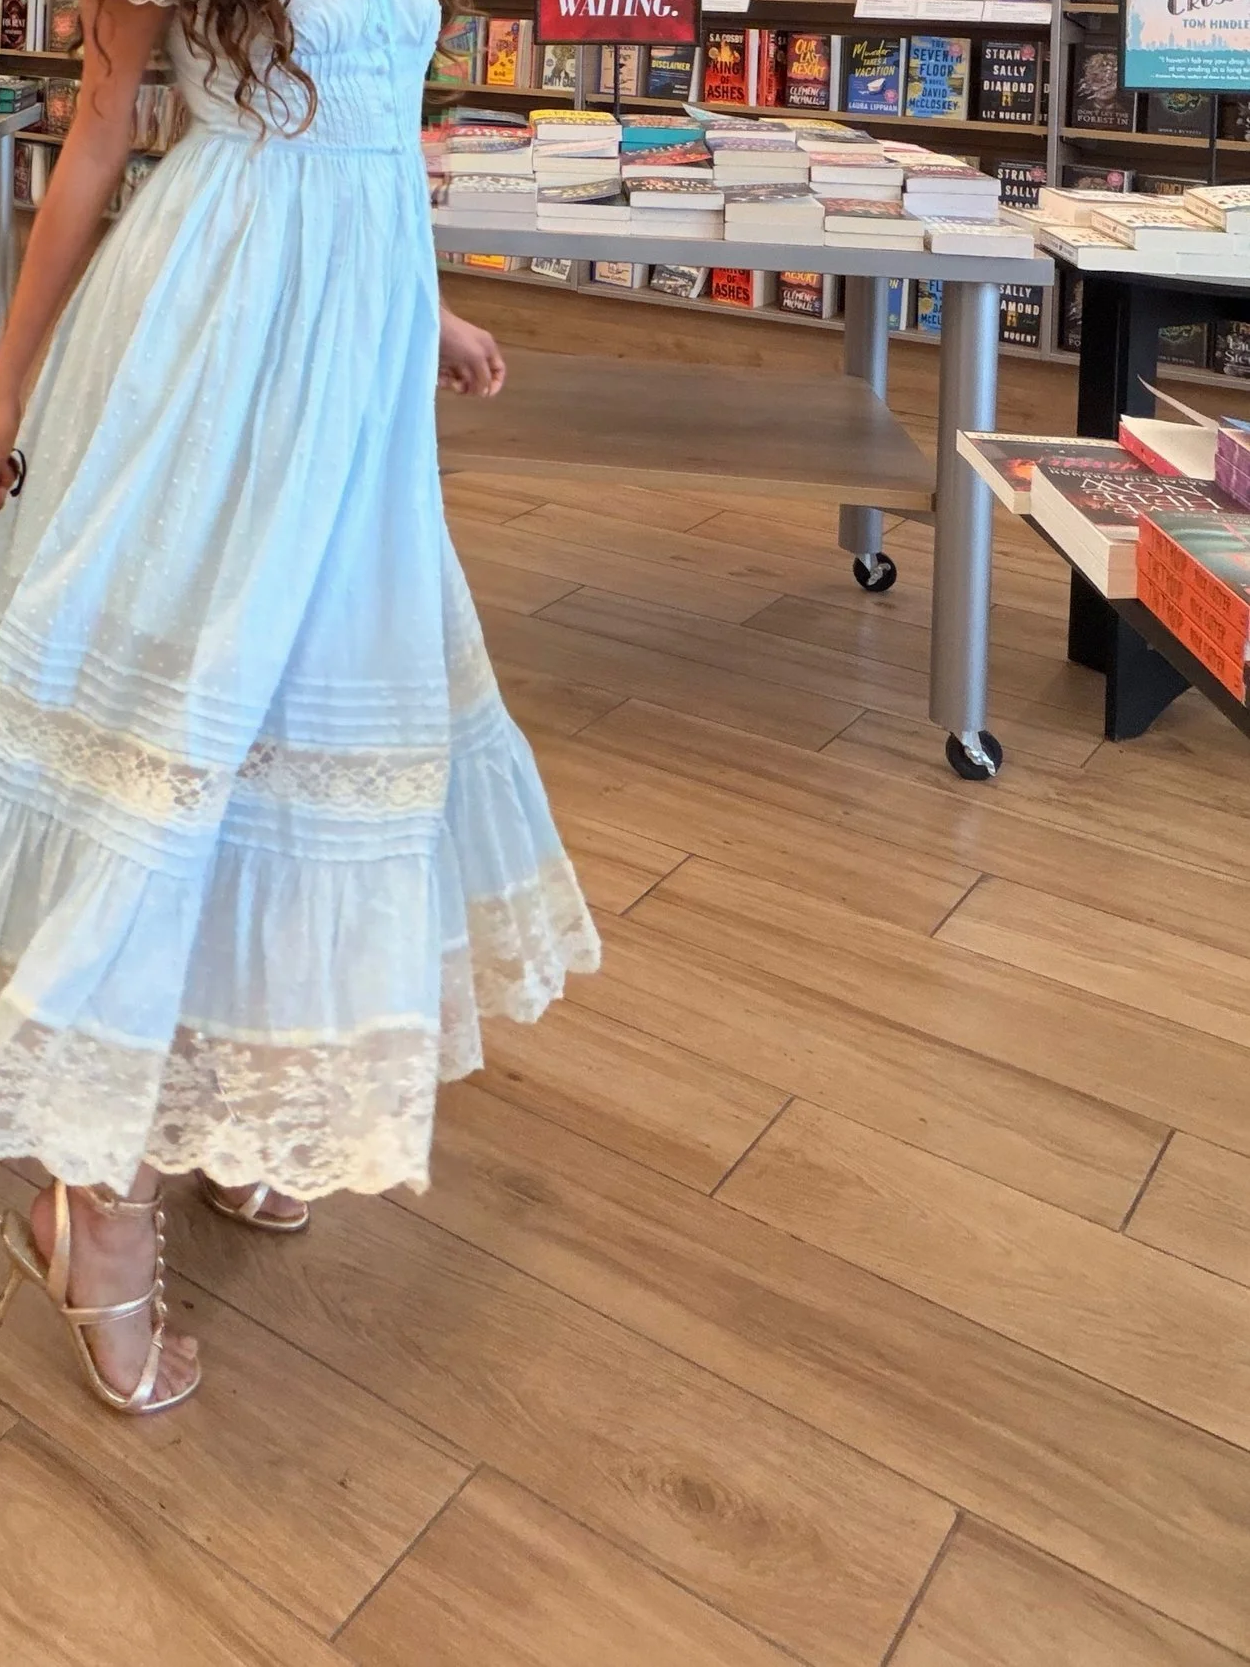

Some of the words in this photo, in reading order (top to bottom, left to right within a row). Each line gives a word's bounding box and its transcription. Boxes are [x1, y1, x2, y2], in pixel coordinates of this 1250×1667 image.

[1183, 19, 1206, 29] TOM
[722, 34, 744, 44] COSBY
[795, 39, 817, 54] OUR
[853, 40, 892, 61] Murder
[800, 52, 820, 64] LAST
[863, 59, 882, 67] TAKES
[652, 60, 692, 72] DISCLAIMER
[712, 61, 740, 75] KING
[792, 62, 826, 79] RESORT
[855, 66, 896, 78] VACATION
[919, 63, 954, 78] FLOOR
[993, 65, 1027, 77] SALLY
[720, 76, 731, 85] OF
[983, 79, 1034, 94] DIAMOND
[707, 86, 745, 101] ASHES
[921, 87, 948, 98] DAVID
[849, 102, 869, 110] LAURA
[870, 103, 898, 111] LIPPMAN
[982, 110, 996, 120] LIZ
[999, 111, 1032, 122] NUGENT
[1078, 115, 1114, 125] FOREST
[1117, 117, 1129, 125] IN
[1005, 185, 1039, 199] SALLY
[727, 275, 736, 284] OF
[714, 283, 750, 302] ASHES
[999, 284, 1032, 298] SALLY
[1000, 299, 1040, 316] AMOND
[1003, 331, 1037, 343] NUGENT
[1080, 478, 1204, 497] NOW
